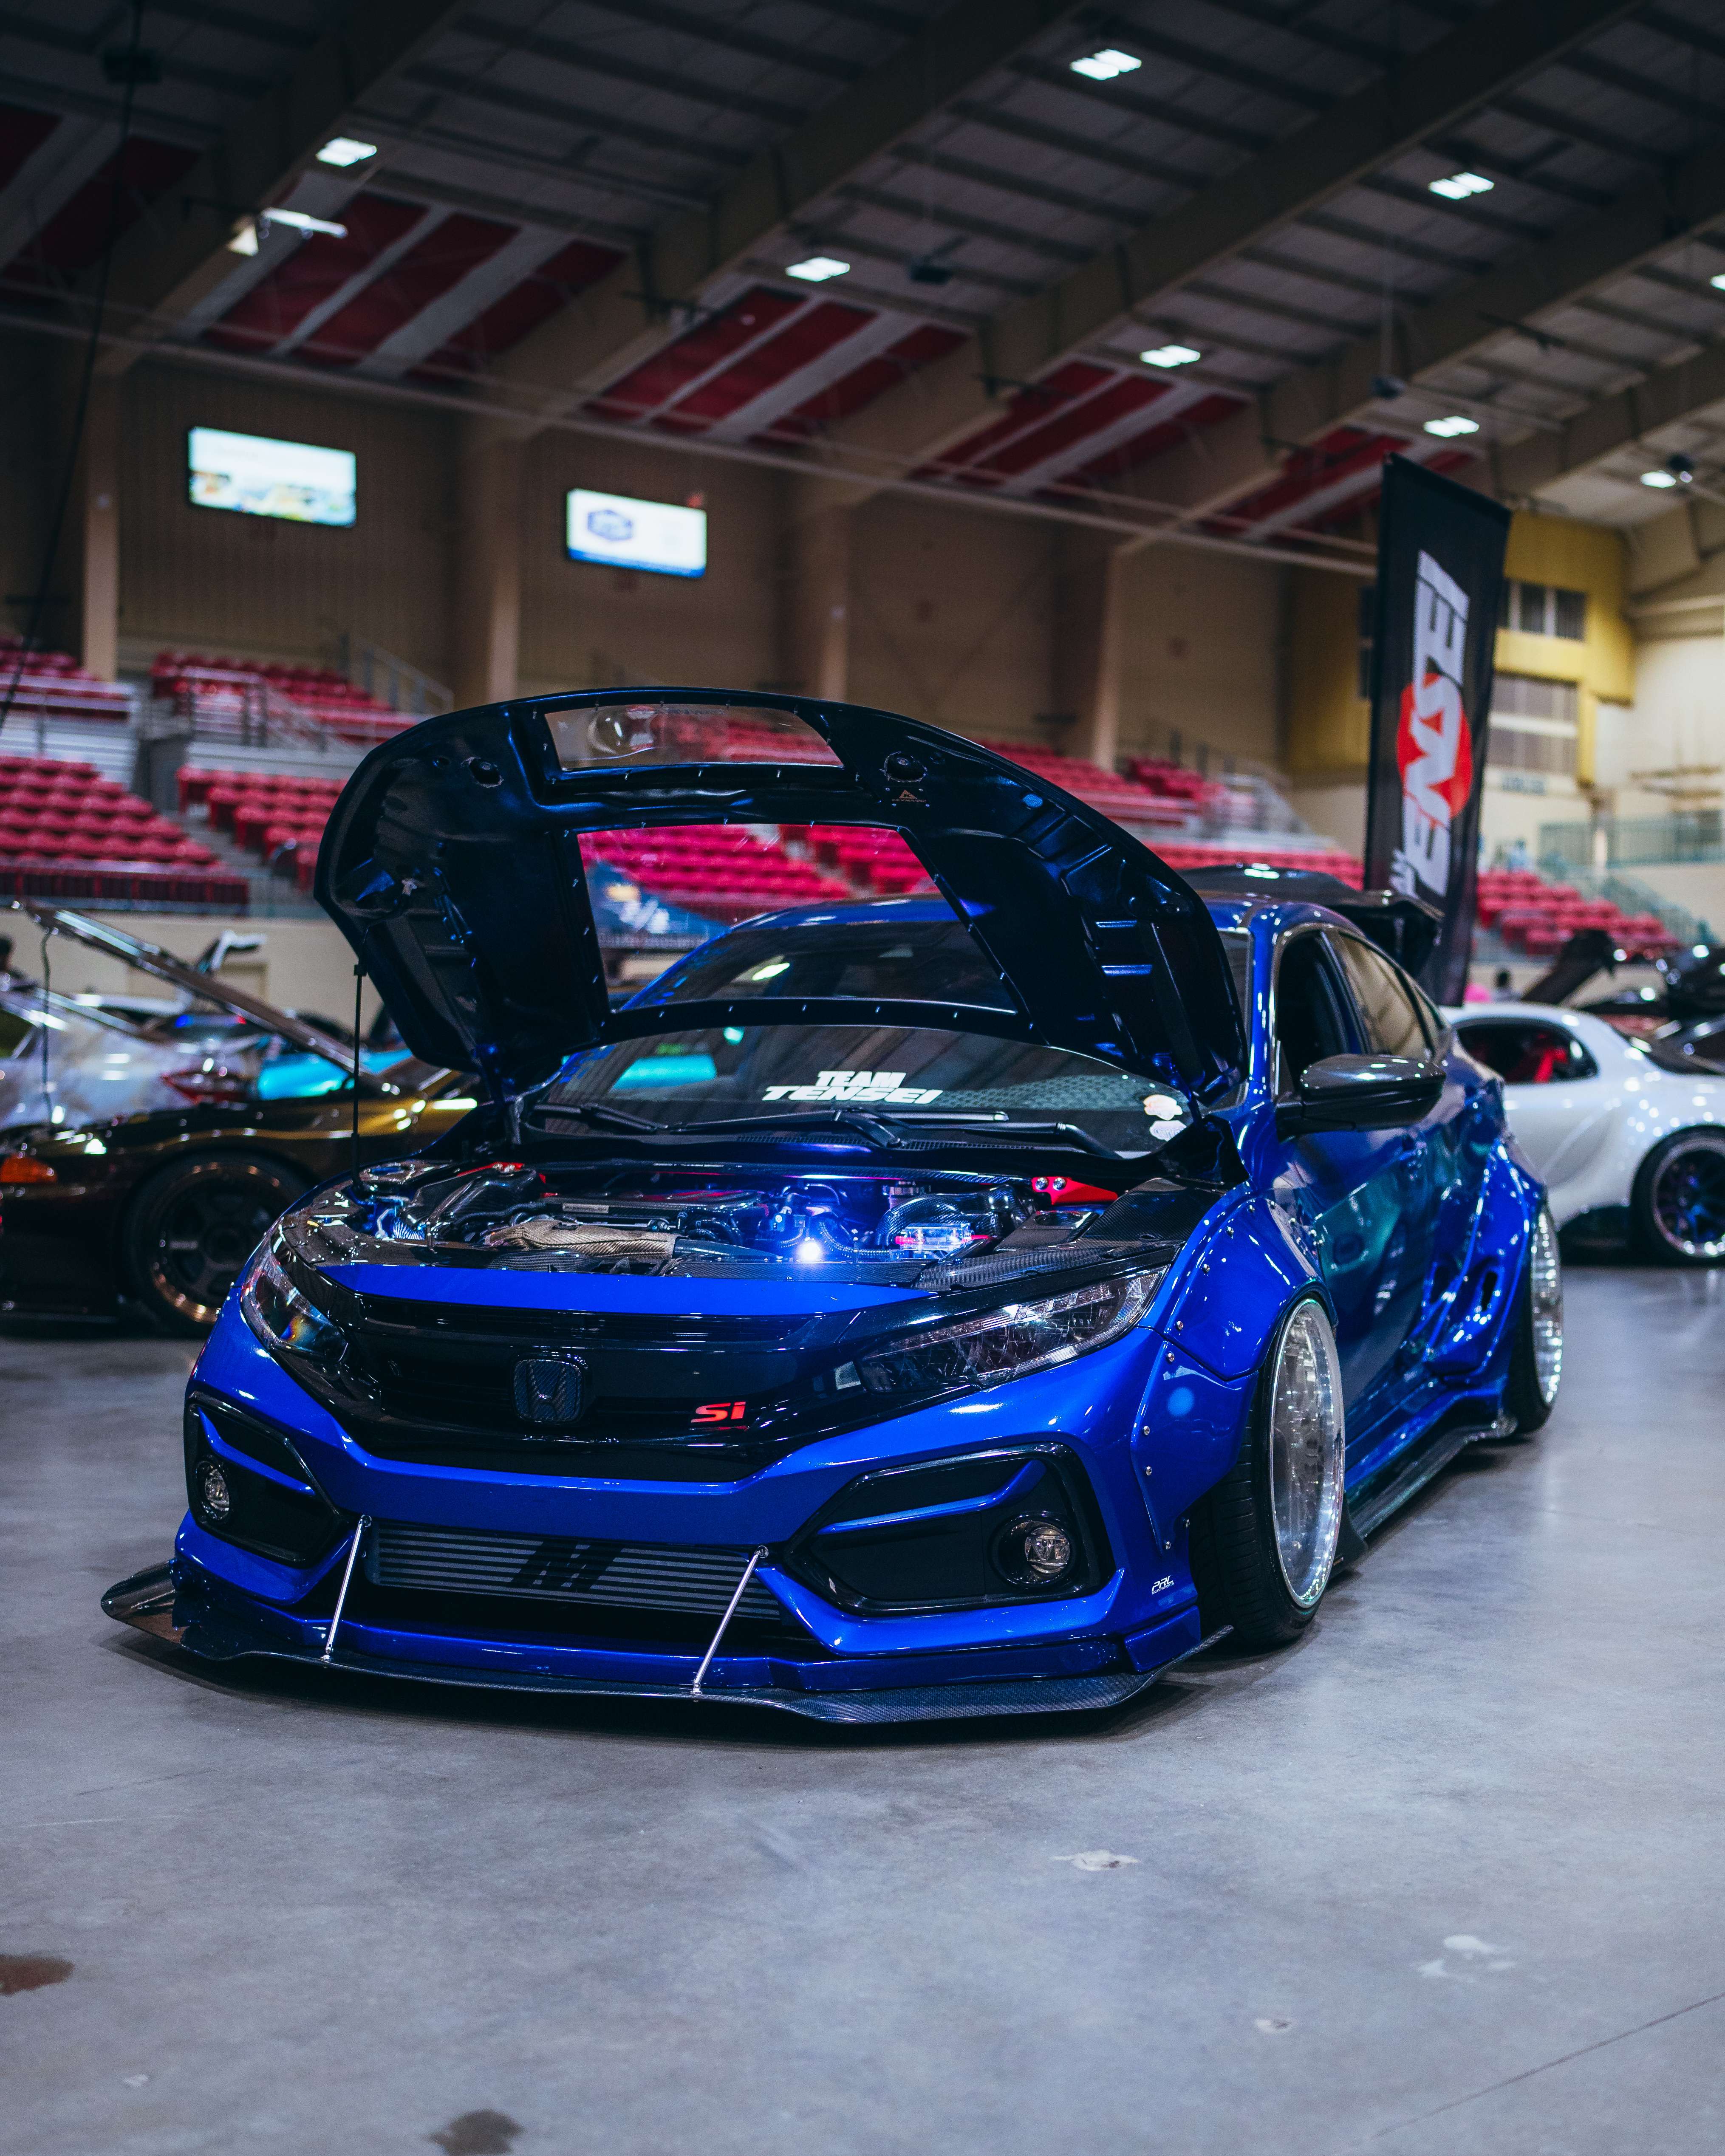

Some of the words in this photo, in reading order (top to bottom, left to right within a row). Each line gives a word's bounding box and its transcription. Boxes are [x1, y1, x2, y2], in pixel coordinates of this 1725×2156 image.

[815, 1071, 906, 1088] TEAM
[762, 1085, 943, 1104] TENSEI
[691, 1402, 746, 1423] Si
[1152, 1575, 1174, 1592] PRL
[1152, 1582, 1174, 1595] MOTORSPORTS
